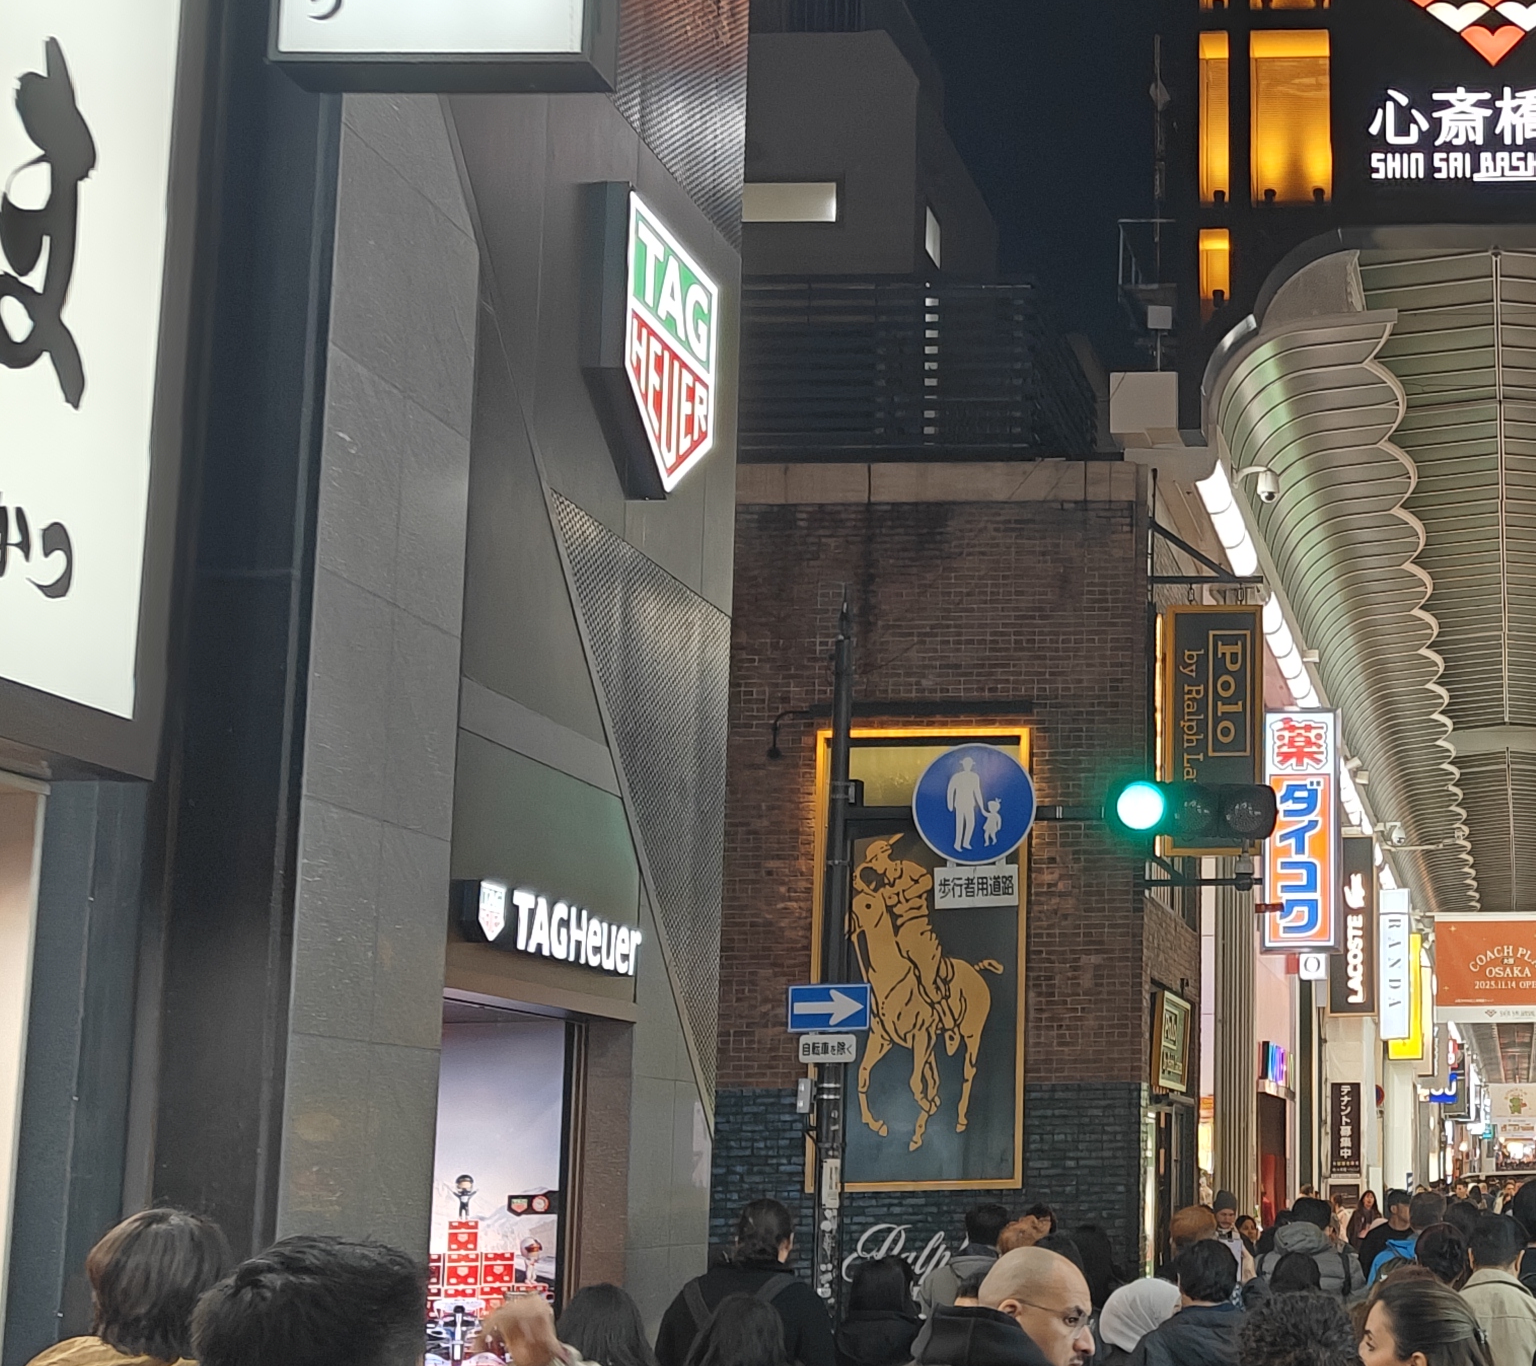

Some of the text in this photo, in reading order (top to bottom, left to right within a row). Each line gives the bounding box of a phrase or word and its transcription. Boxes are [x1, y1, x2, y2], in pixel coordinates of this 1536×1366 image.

[1370, 152, 1424, 179] SHIN
[1433, 152, 1471, 179] SAI
[636, 227, 711, 349] TAG
[630, 323, 710, 468] HEUER
[1179, 649, 1205, 679] by
[1216, 640, 1243, 744] Polo
[1180, 683, 1205, 749] Ralph
[1271, 718, 1328, 770] 薬
[1278, 779, 1322, 935] ダイコク
[938, 875, 1015, 900] 歩行者用道路
[1347, 914, 1366, 1005] LACOSTE
[1388, 918, 1402, 1009] RANDA
[1469, 945, 1513, 972] COACH
[1474, 980, 1516, 990] 2025.11.14
[1485, 966, 1532, 978] OSAKA
[802, 1041, 853, 1057] 自転車を除く
[1339, 1085, 1352, 1160] テナント募集中
